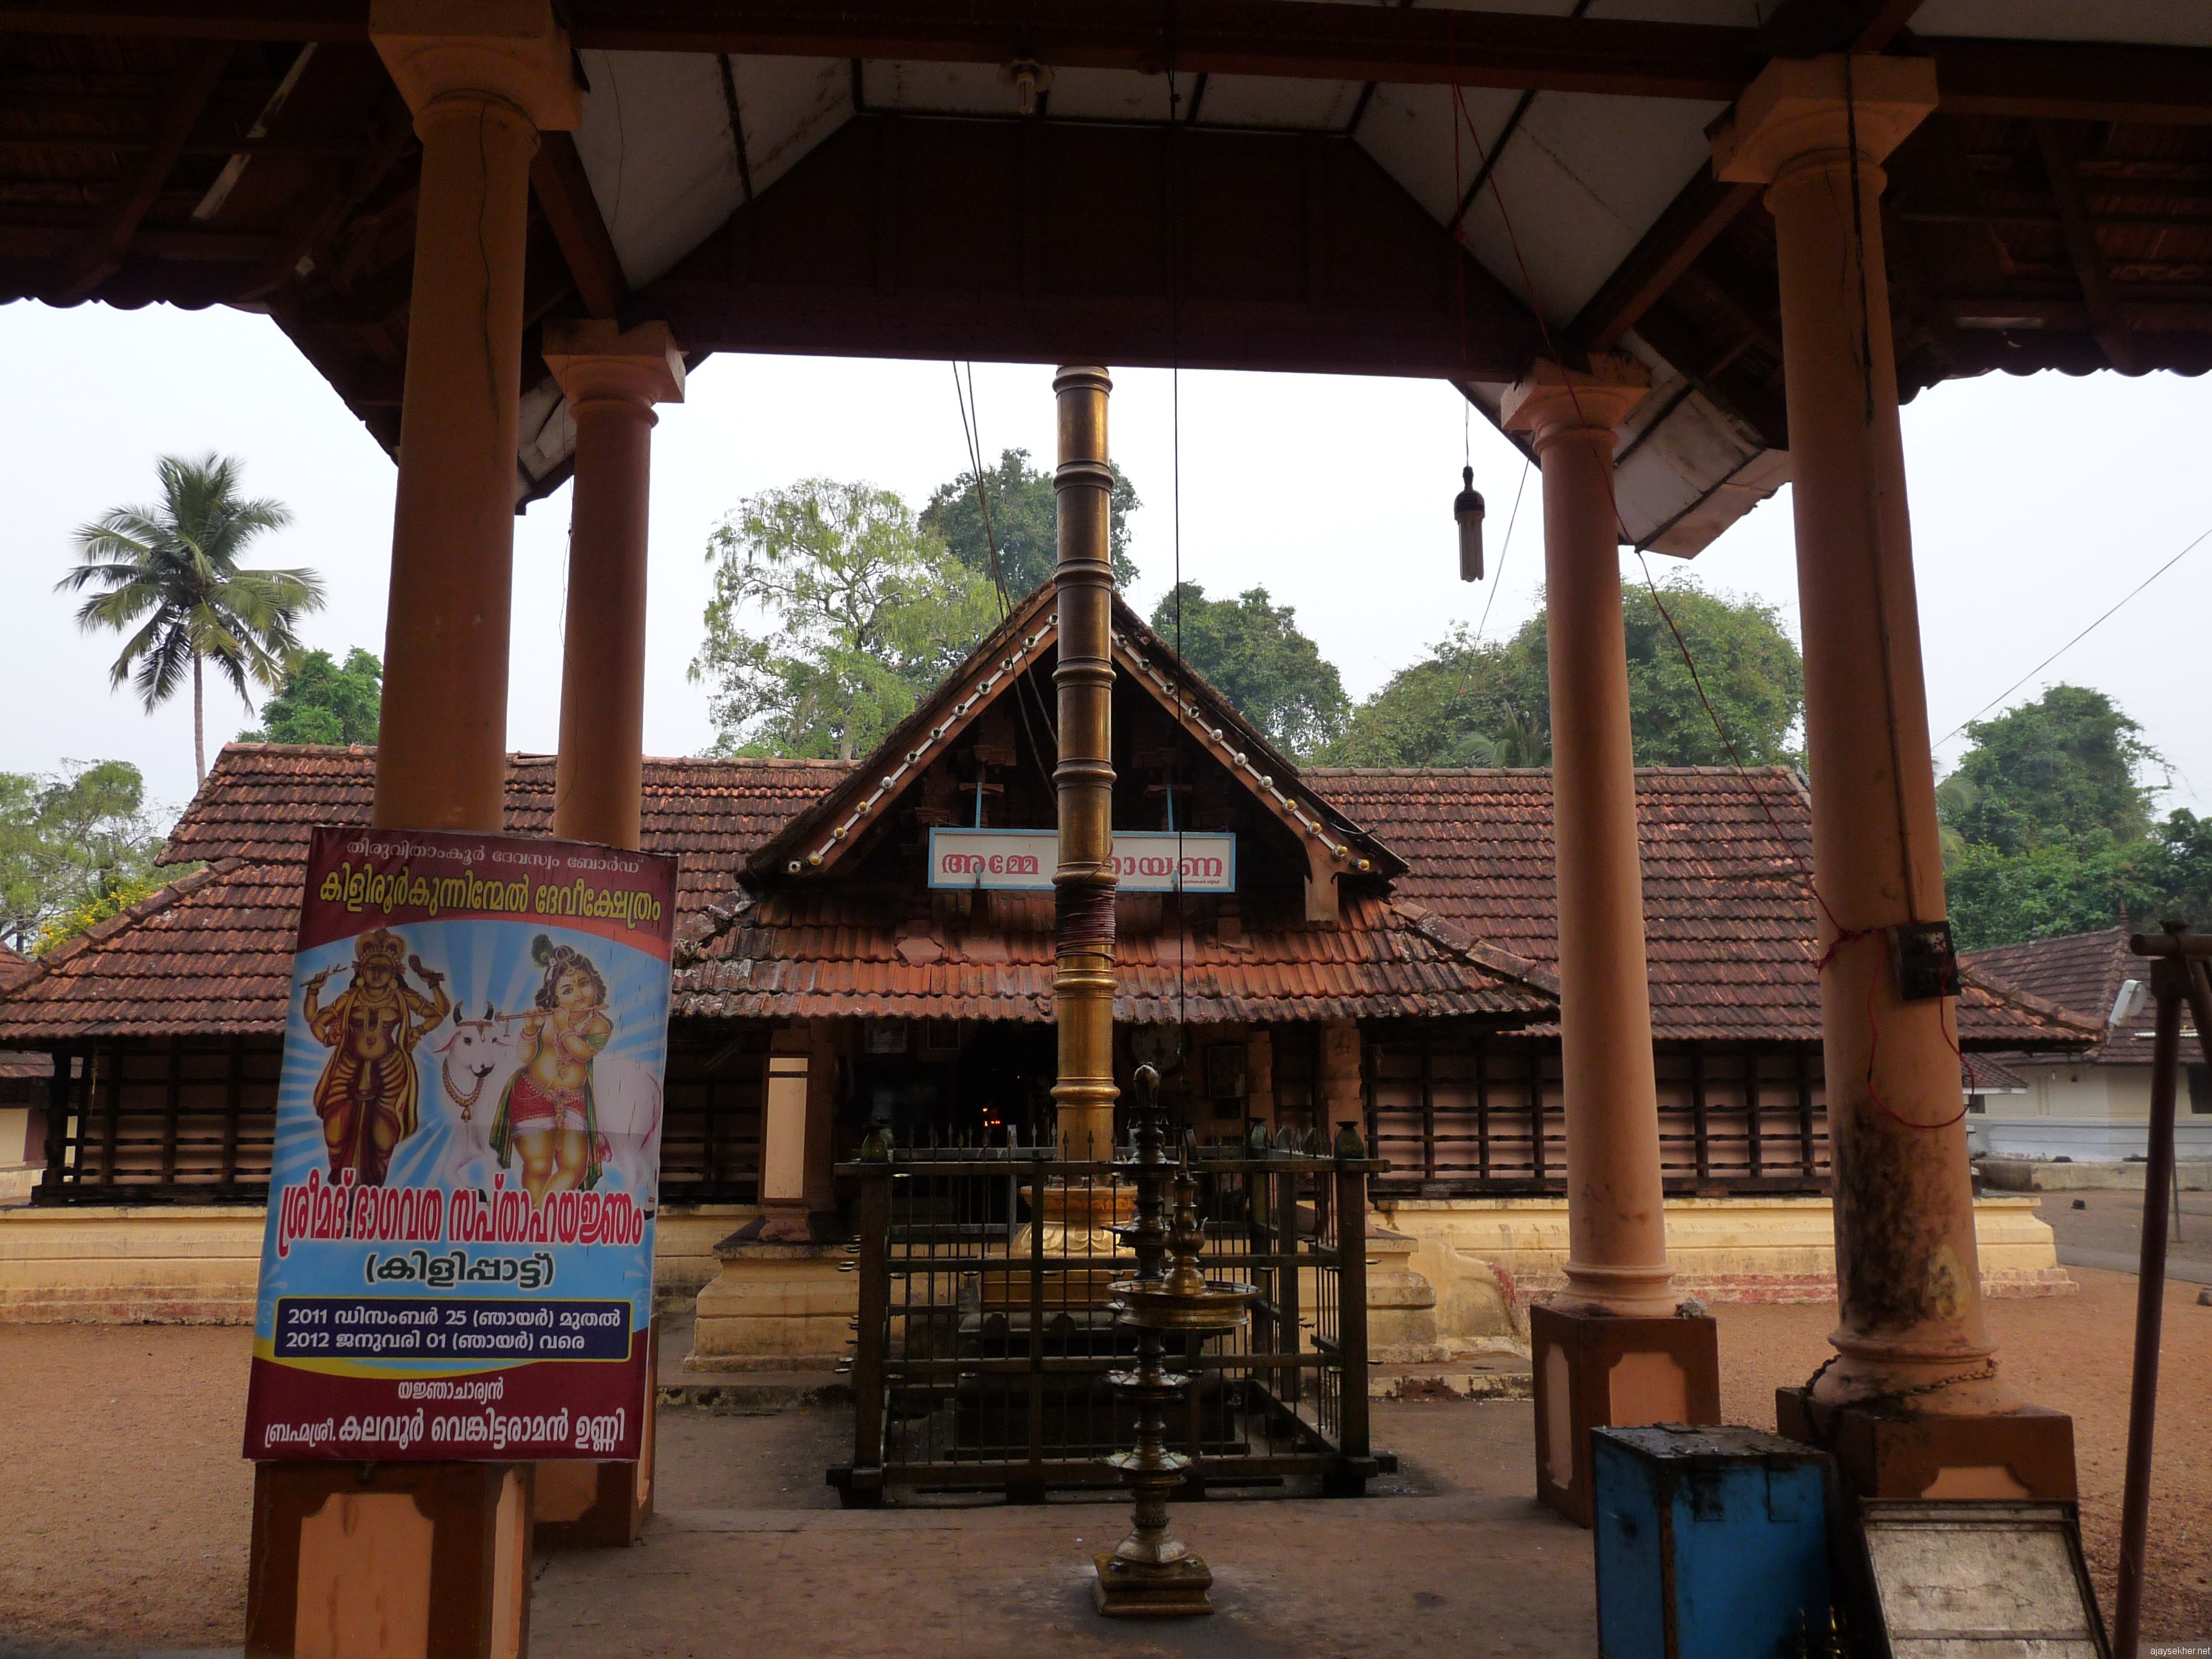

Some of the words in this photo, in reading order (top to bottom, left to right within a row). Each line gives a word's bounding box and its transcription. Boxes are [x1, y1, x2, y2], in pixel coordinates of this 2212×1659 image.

[347, 837, 484, 865] തിരുവിതാംകൂർ
[492, 851, 560, 869] ദേവസ്വം
[567, 856, 644, 873] ബോർഡ്
[942, 854, 1039, 874] അമ്മേ
[320, 861, 529, 917] കിളിരൂർകുന്നിന്മേൽ
[535, 877, 662, 930] ദേവീക്ഷേത്രം
[278, 1168, 354, 1258] ശ്രീമദ്
[352, 1187, 443, 1241] ഭാഗവത
[449, 1173, 643, 1245] സപ്താഹയജ്ഞം
[366, 1250, 554, 1289] (കിളിപ്പാട്ട്)
[288, 1309, 327, 1324] 2011
[335, 1306, 438, 1325] ഡിസംബർ
[445, 1310, 467, 1326] 25
[473, 1308, 554, 1327] (ഞായർ)
[559, 1309, 621, 1330] മുതൽ
[286, 1332, 330, 1347] 2012
[335, 1330, 420, 1352] ജനുവരി
[426, 1333, 446, 1348] 01
[452, 1331, 534, 1351] (ഞായർ)
[539, 1335, 585, 1349] വരെ
[398, 1376, 504, 1405] യജ്ഞാചാര്യൻ
[264, 1418, 337, 1448] ബ്രഹ്മശ്രീ.
[338, 1407, 424, 1450] കലവൂർ
[431, 1407, 569, 1450] വെങ്കിട്ടരാമൻ
[575, 1407, 626, 1452] ഉണ്ണി
